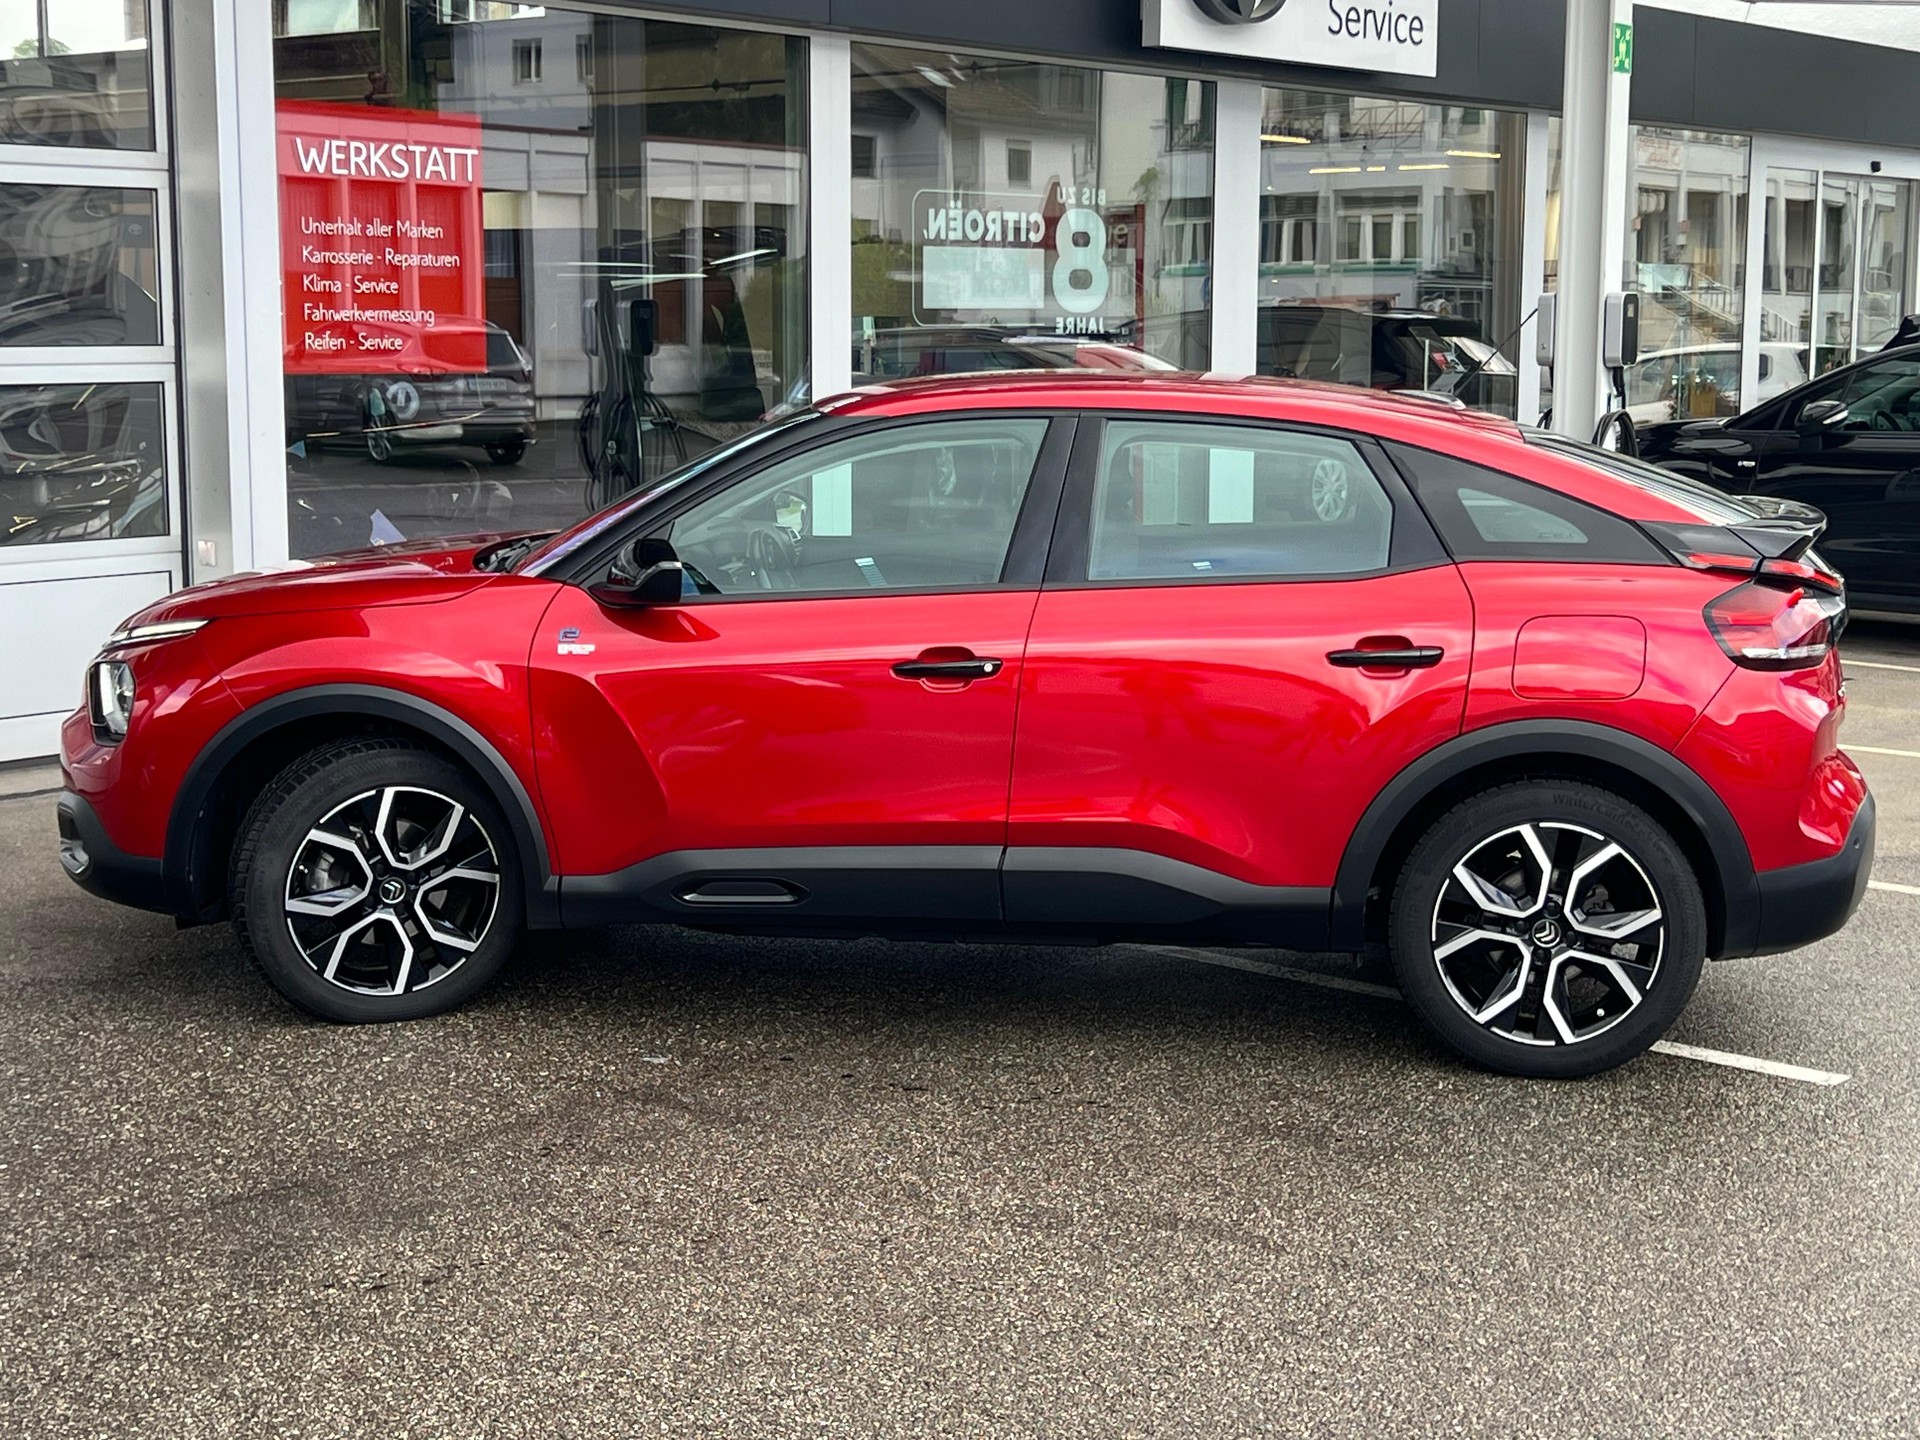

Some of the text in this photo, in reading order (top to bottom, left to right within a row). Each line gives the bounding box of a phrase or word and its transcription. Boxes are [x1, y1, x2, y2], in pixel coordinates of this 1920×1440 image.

[1327, 0, 1424, 46] Service
[296, 137, 479, 182] WERKSTATT
[301, 216, 443, 239] Unterhalt aller Marken
[302, 245, 373, 266] Karrosserie
[385, 248, 460, 271] Reparaturen
[303, 273, 342, 293] Klima
[353, 275, 399, 295] Service
[304, 303, 435, 328] Fahrwerkvermessung
[304, 331, 346, 351] Reifen
[358, 332, 403, 351] Service
